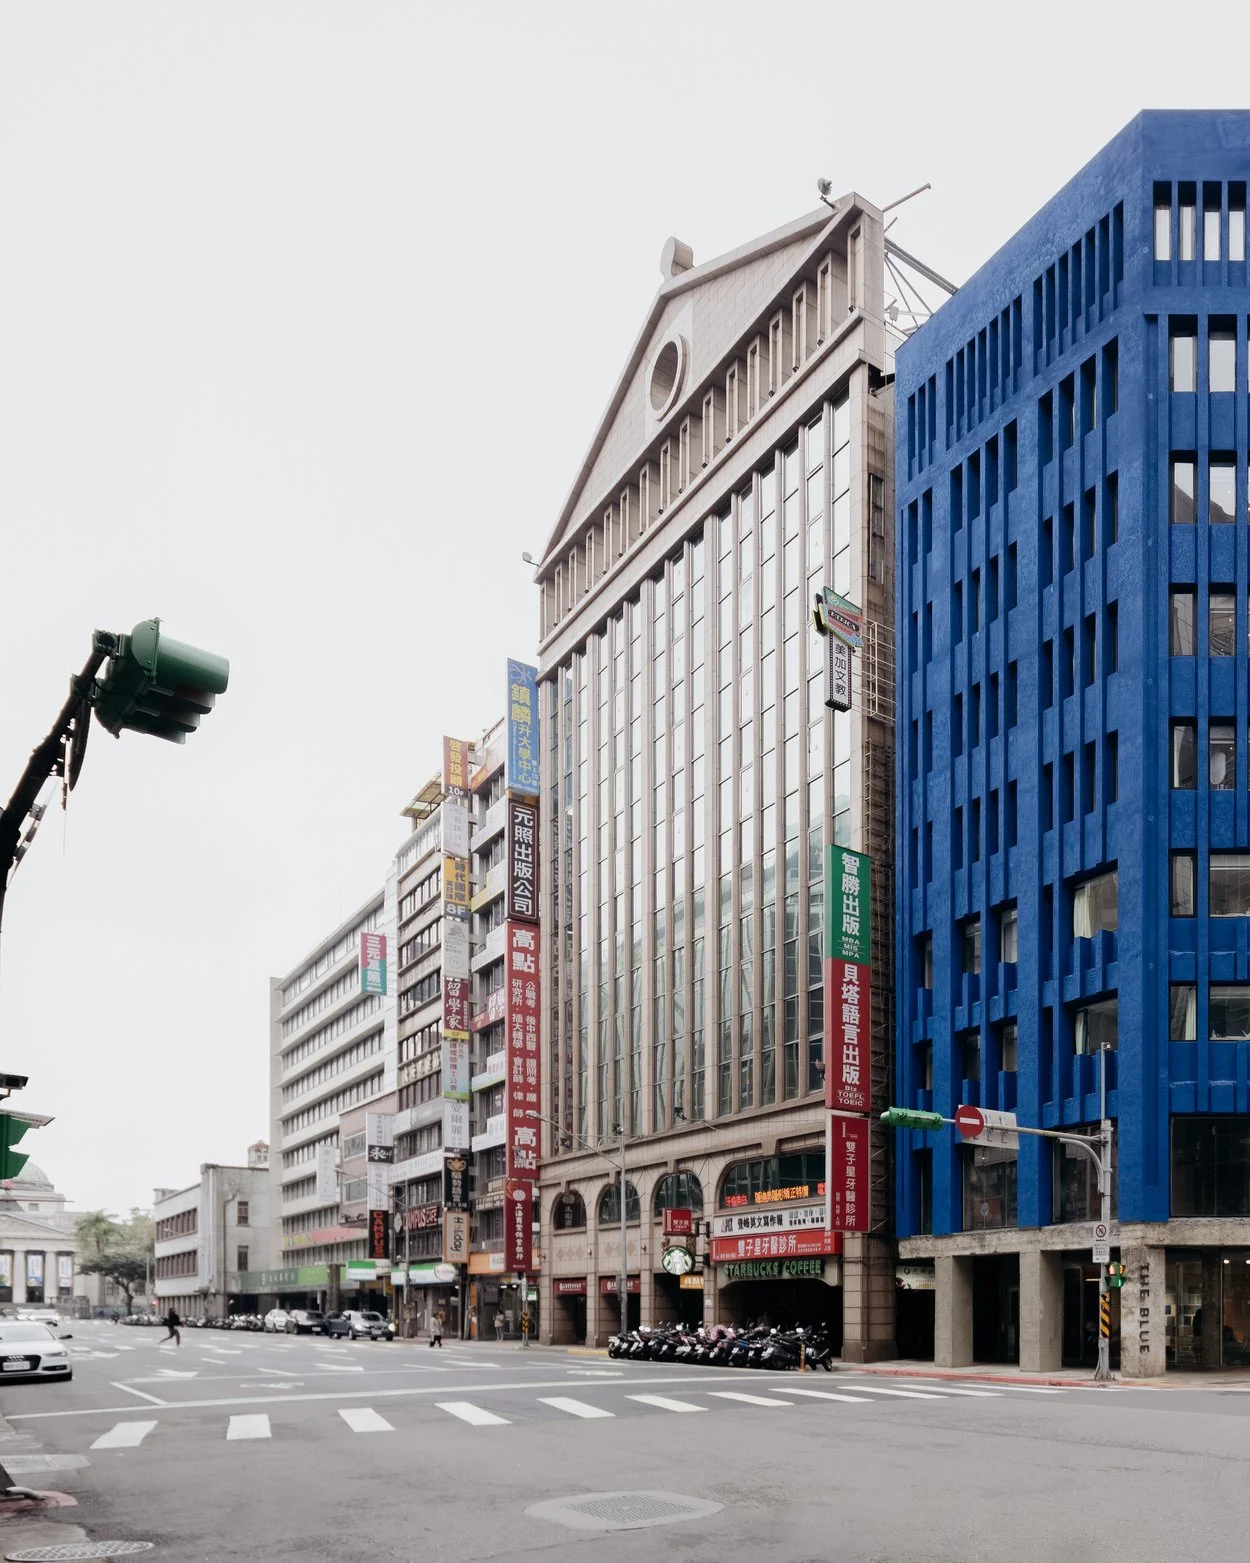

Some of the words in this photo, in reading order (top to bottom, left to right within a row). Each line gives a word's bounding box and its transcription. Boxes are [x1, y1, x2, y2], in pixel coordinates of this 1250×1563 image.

[834, 643, 847, 698] 美加文教
[513, 806, 535, 915] 元照出版公司
[445, 903, 466, 916] 8F
[841, 852, 860, 937] 智勝出版
[512, 929, 535, 974] 高點
[841, 950, 861, 958] MPA
[842, 936, 861, 945] MBA
[446, 982, 463, 1029] 留學家
[841, 963, 861, 1085] 貝塔語言出版
[837, 1090, 865, 1099] TOEFL
[838, 1097, 864, 1107] TOEIC
[510, 1127, 532, 1171] 高點
[845, 1141, 856, 1226] 雙子星牙醫診所
[450, 1216, 464, 1251] Holiday
[737, 1234, 797, 1257] 雙子星牙醫診所
[723, 1260, 779, 1277] STARBUCKS
[784, 1260, 822, 1274] COFFEE
[1139, 1262, 1150, 1301] THE
[1139, 1307, 1150, 1354] BLUE
